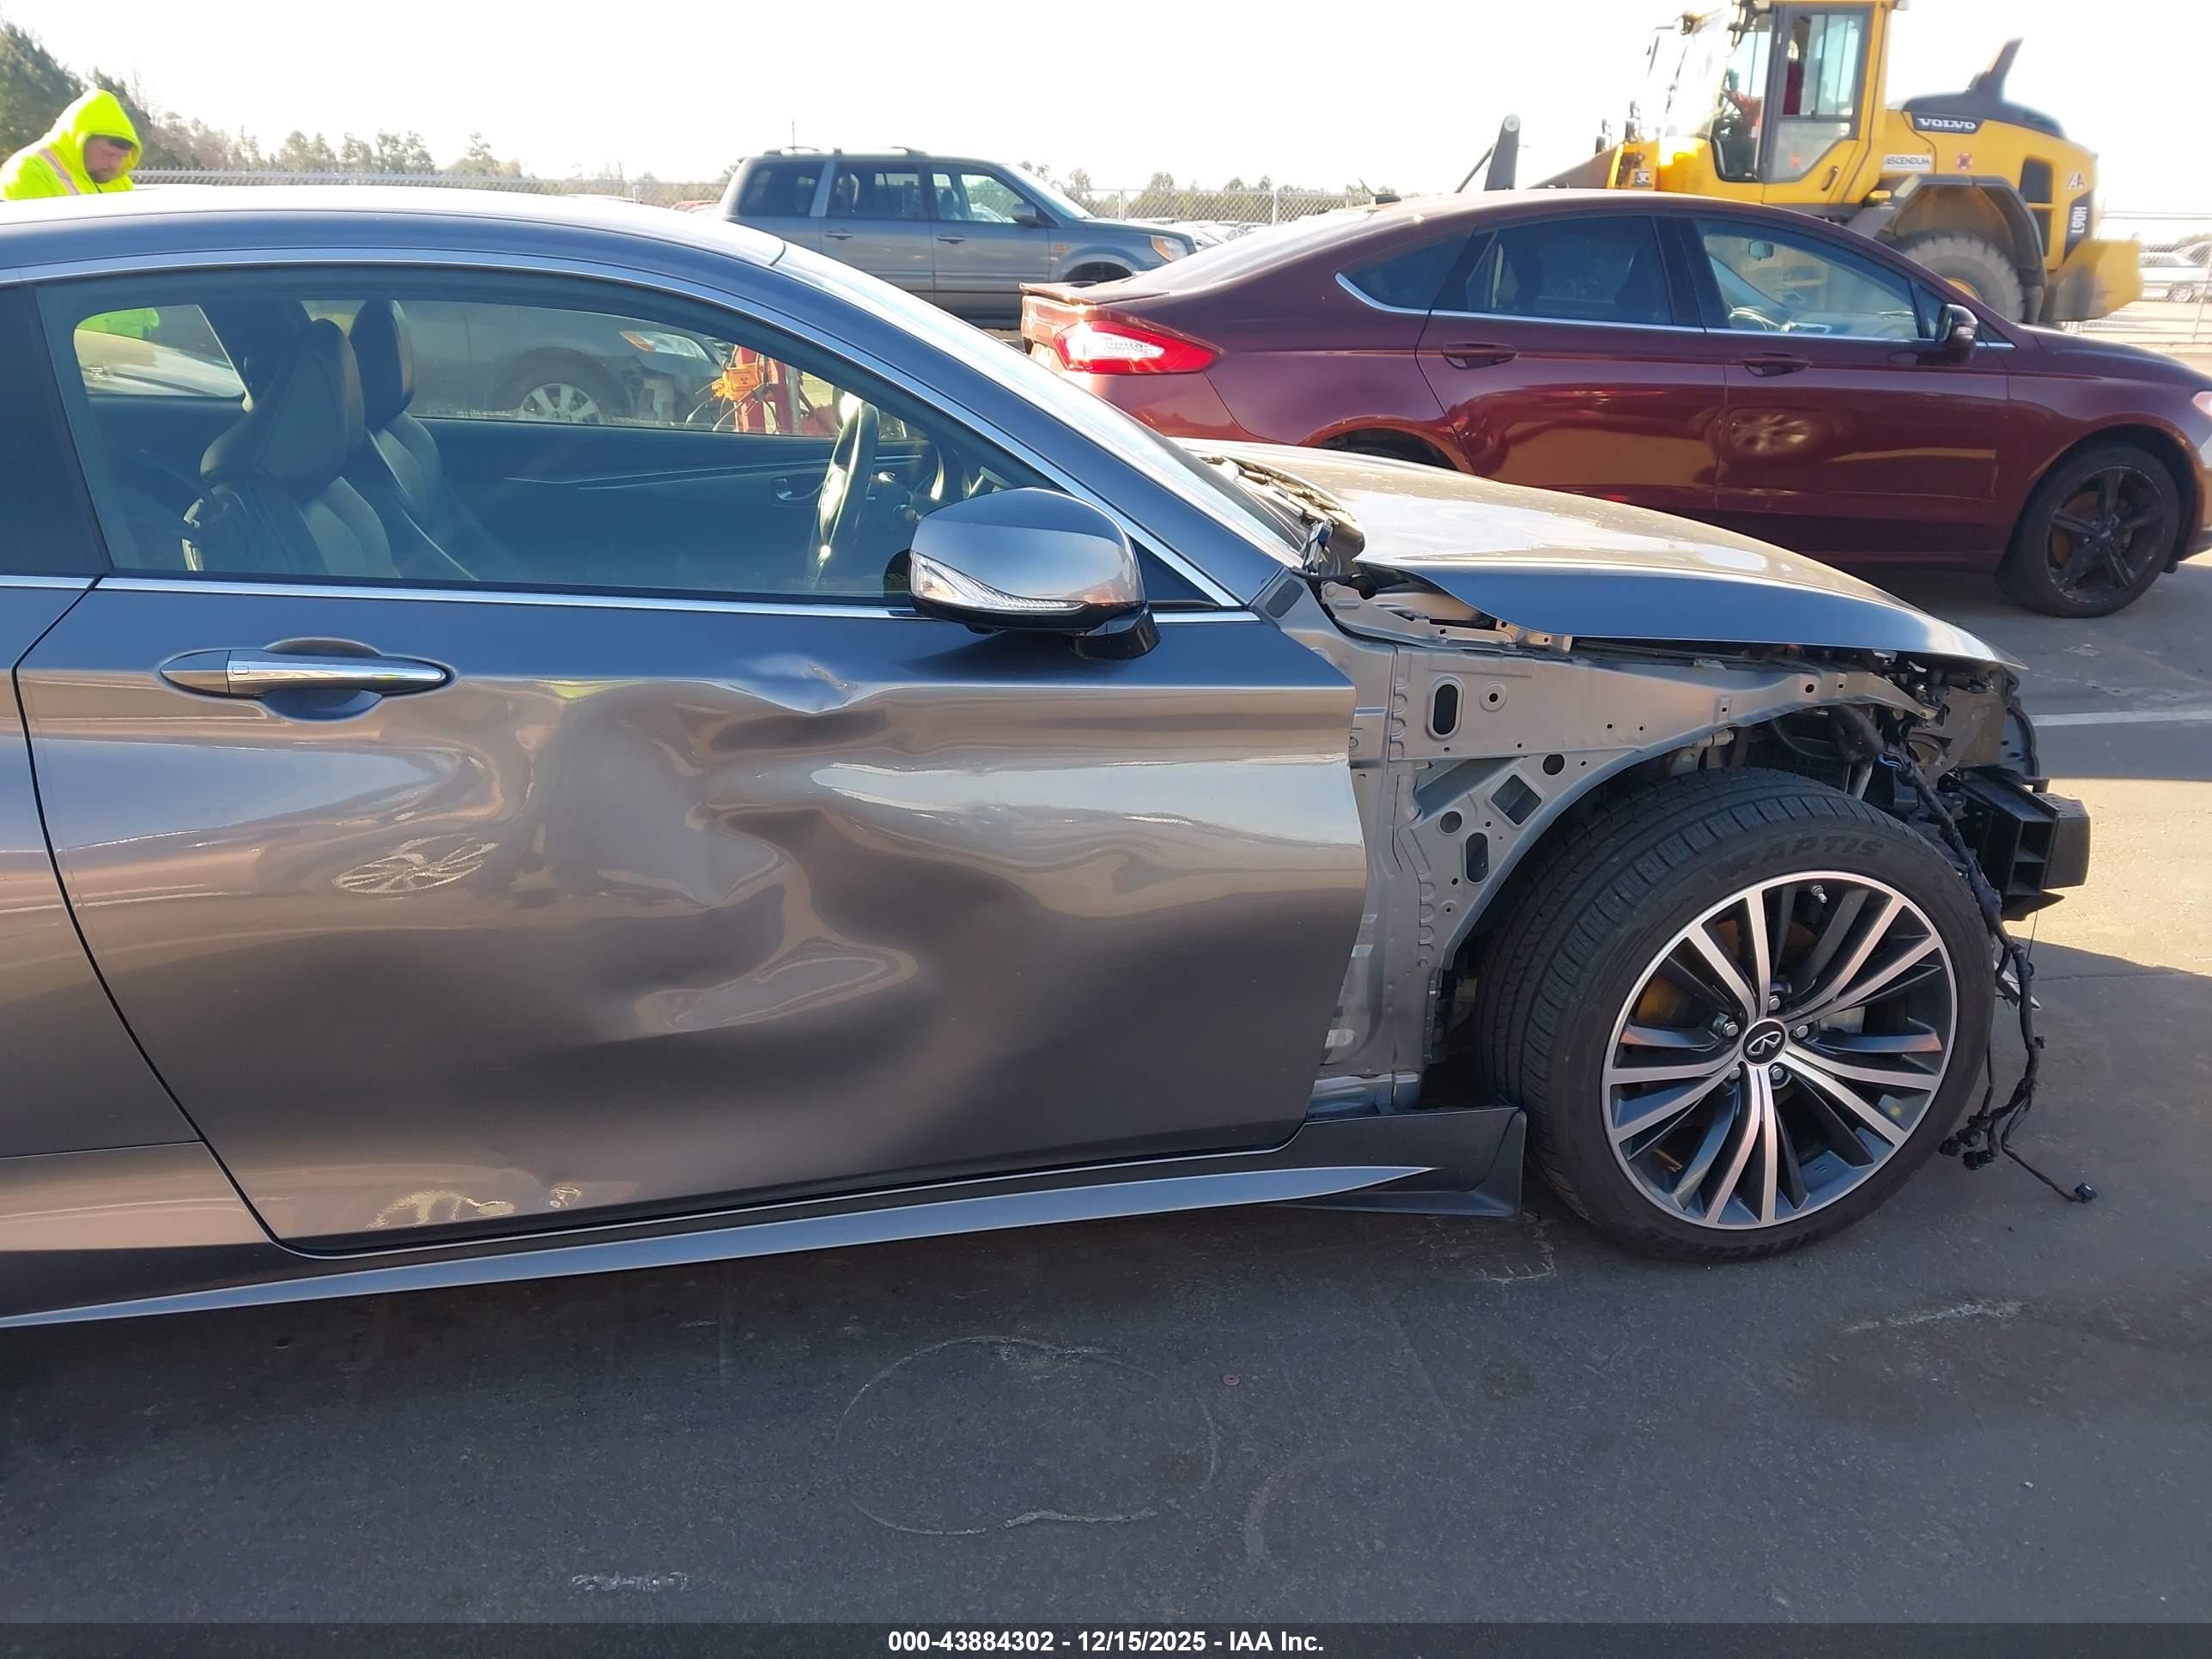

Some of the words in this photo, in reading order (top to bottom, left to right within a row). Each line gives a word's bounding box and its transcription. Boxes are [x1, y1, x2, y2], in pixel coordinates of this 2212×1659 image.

[1917, 118, 1977, 130] VOLVO
[1885, 156, 1931, 166] ASCENDUM
[2070, 206, 2088, 234] L90H
